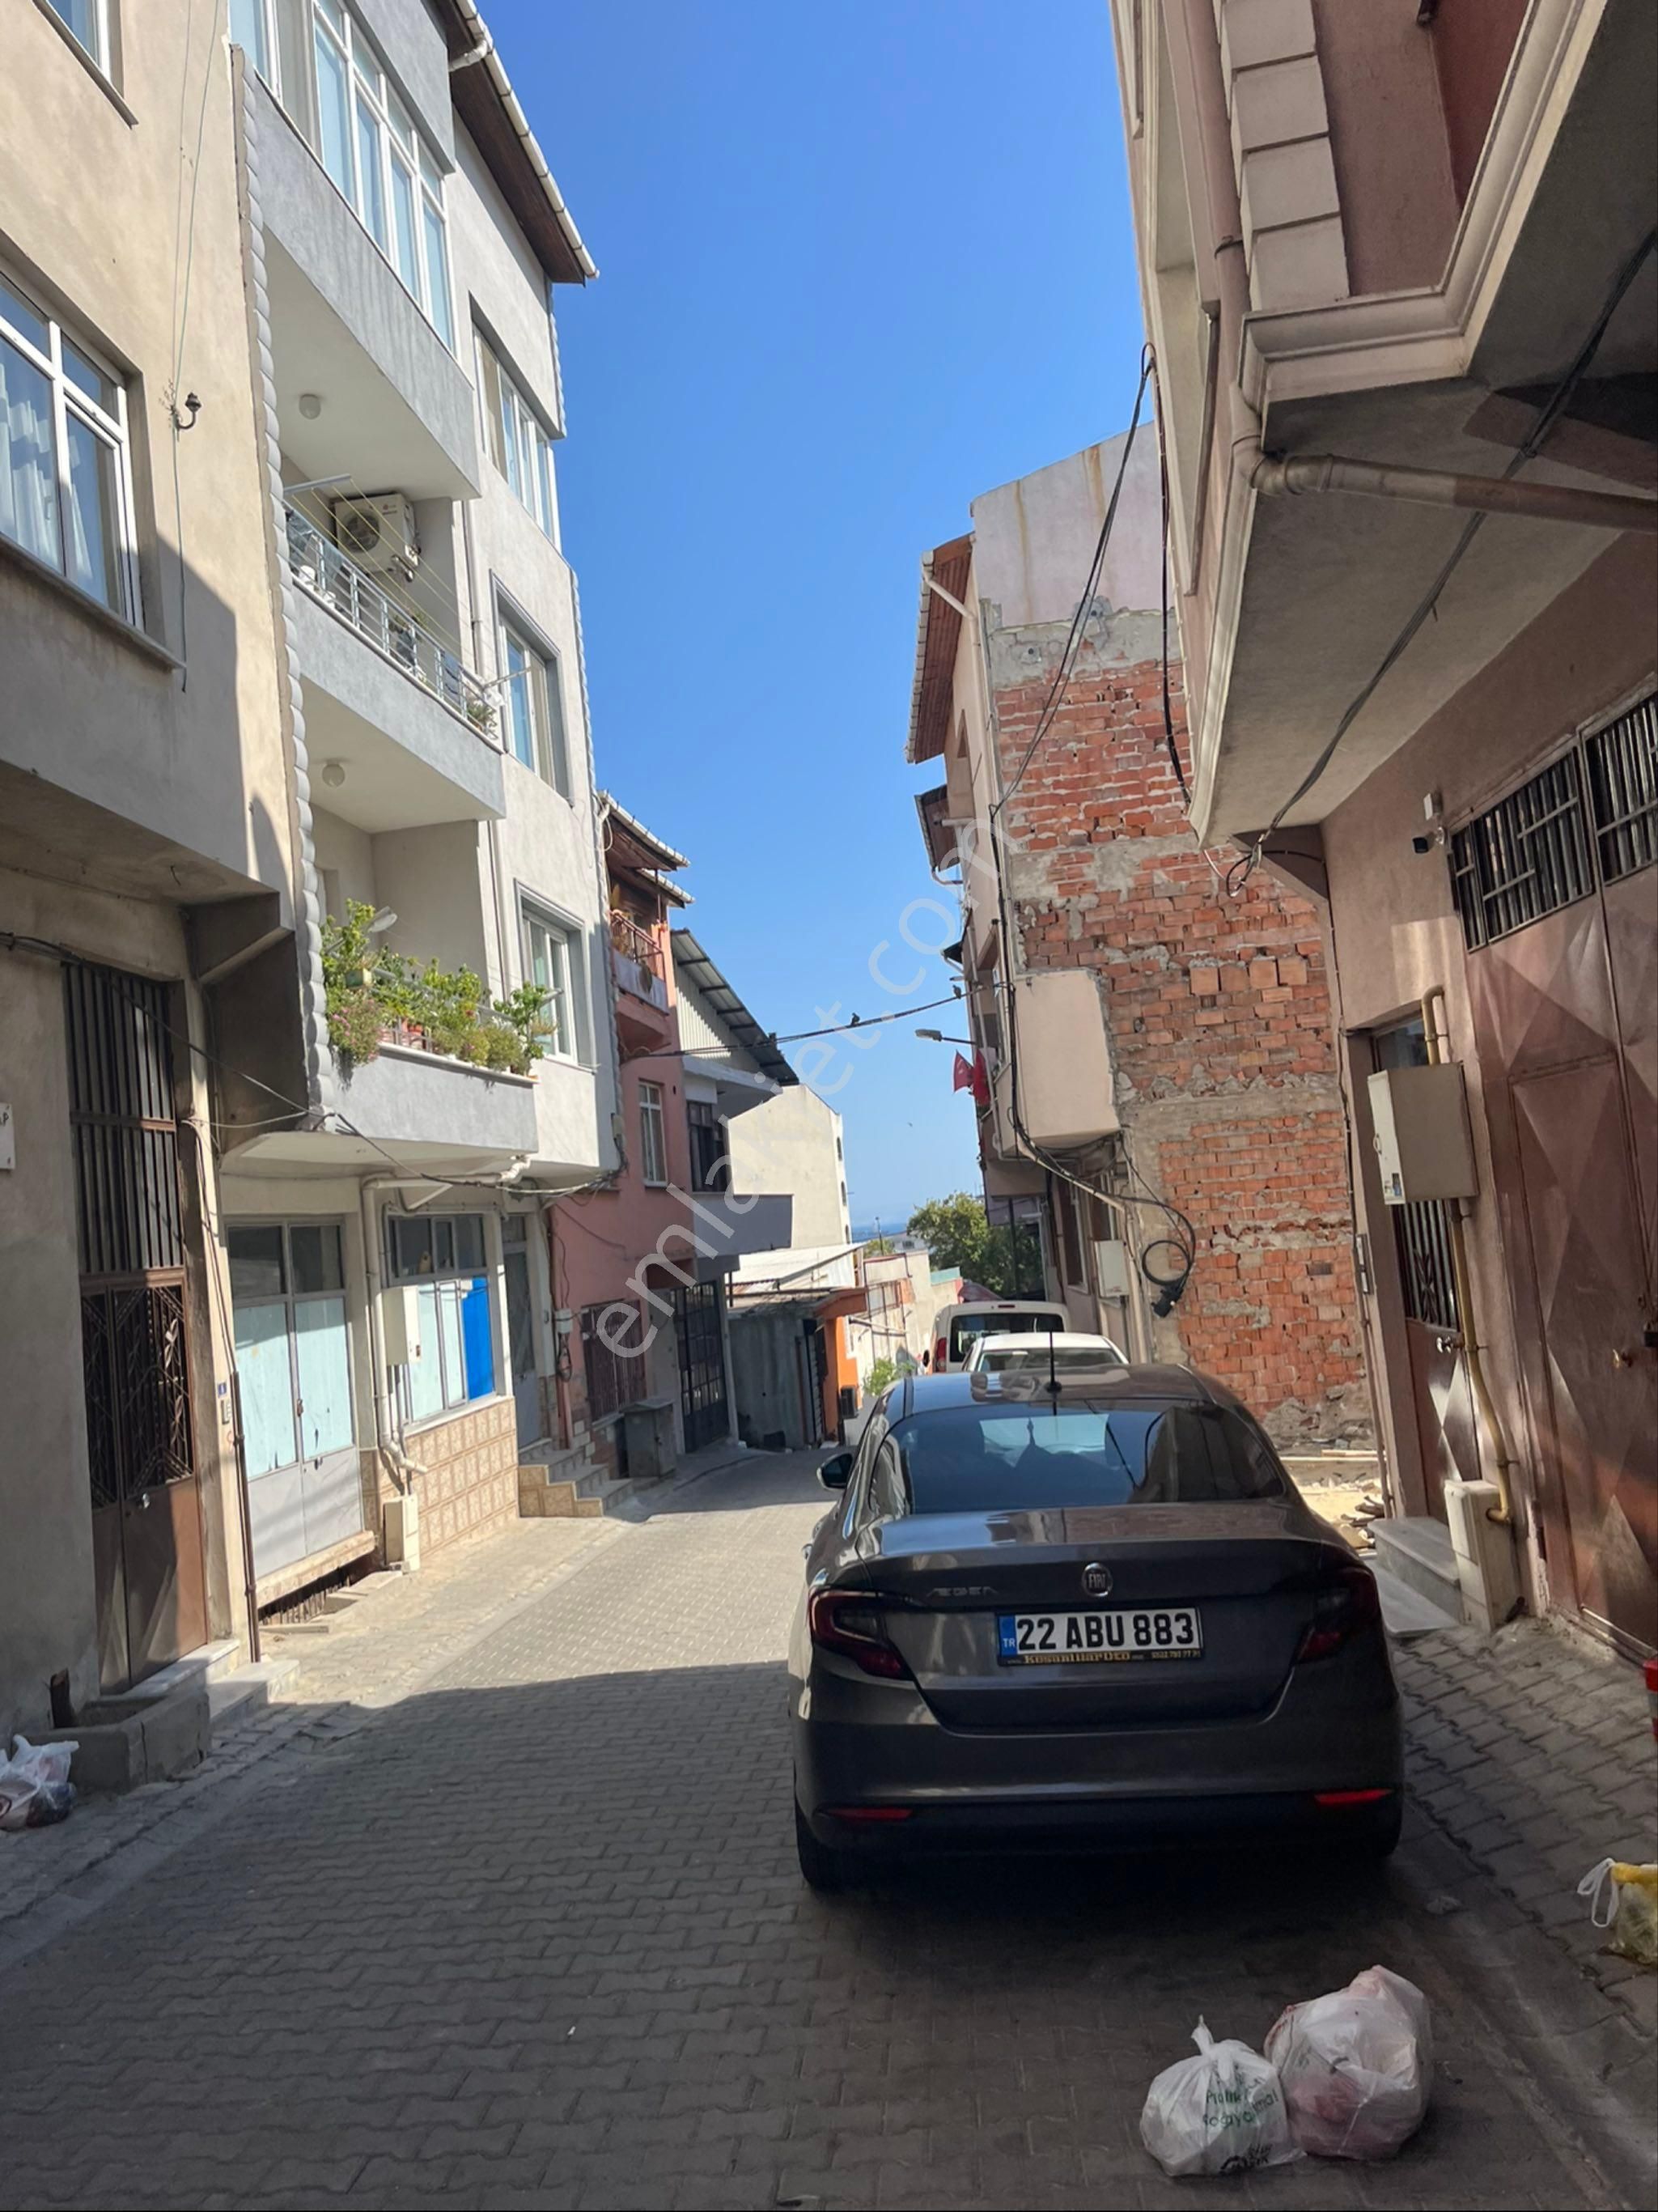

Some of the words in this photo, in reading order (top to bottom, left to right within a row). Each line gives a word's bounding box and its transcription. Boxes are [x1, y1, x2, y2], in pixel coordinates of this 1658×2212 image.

[1088, 1573, 1106, 1590] FIAT
[1017, 1619, 1056, 1650] 22
[1066, 1615, 1125, 1649] ABU
[1133, 1612, 1194, 1646] 883
[1003, 1638, 1016, 1648] TR
